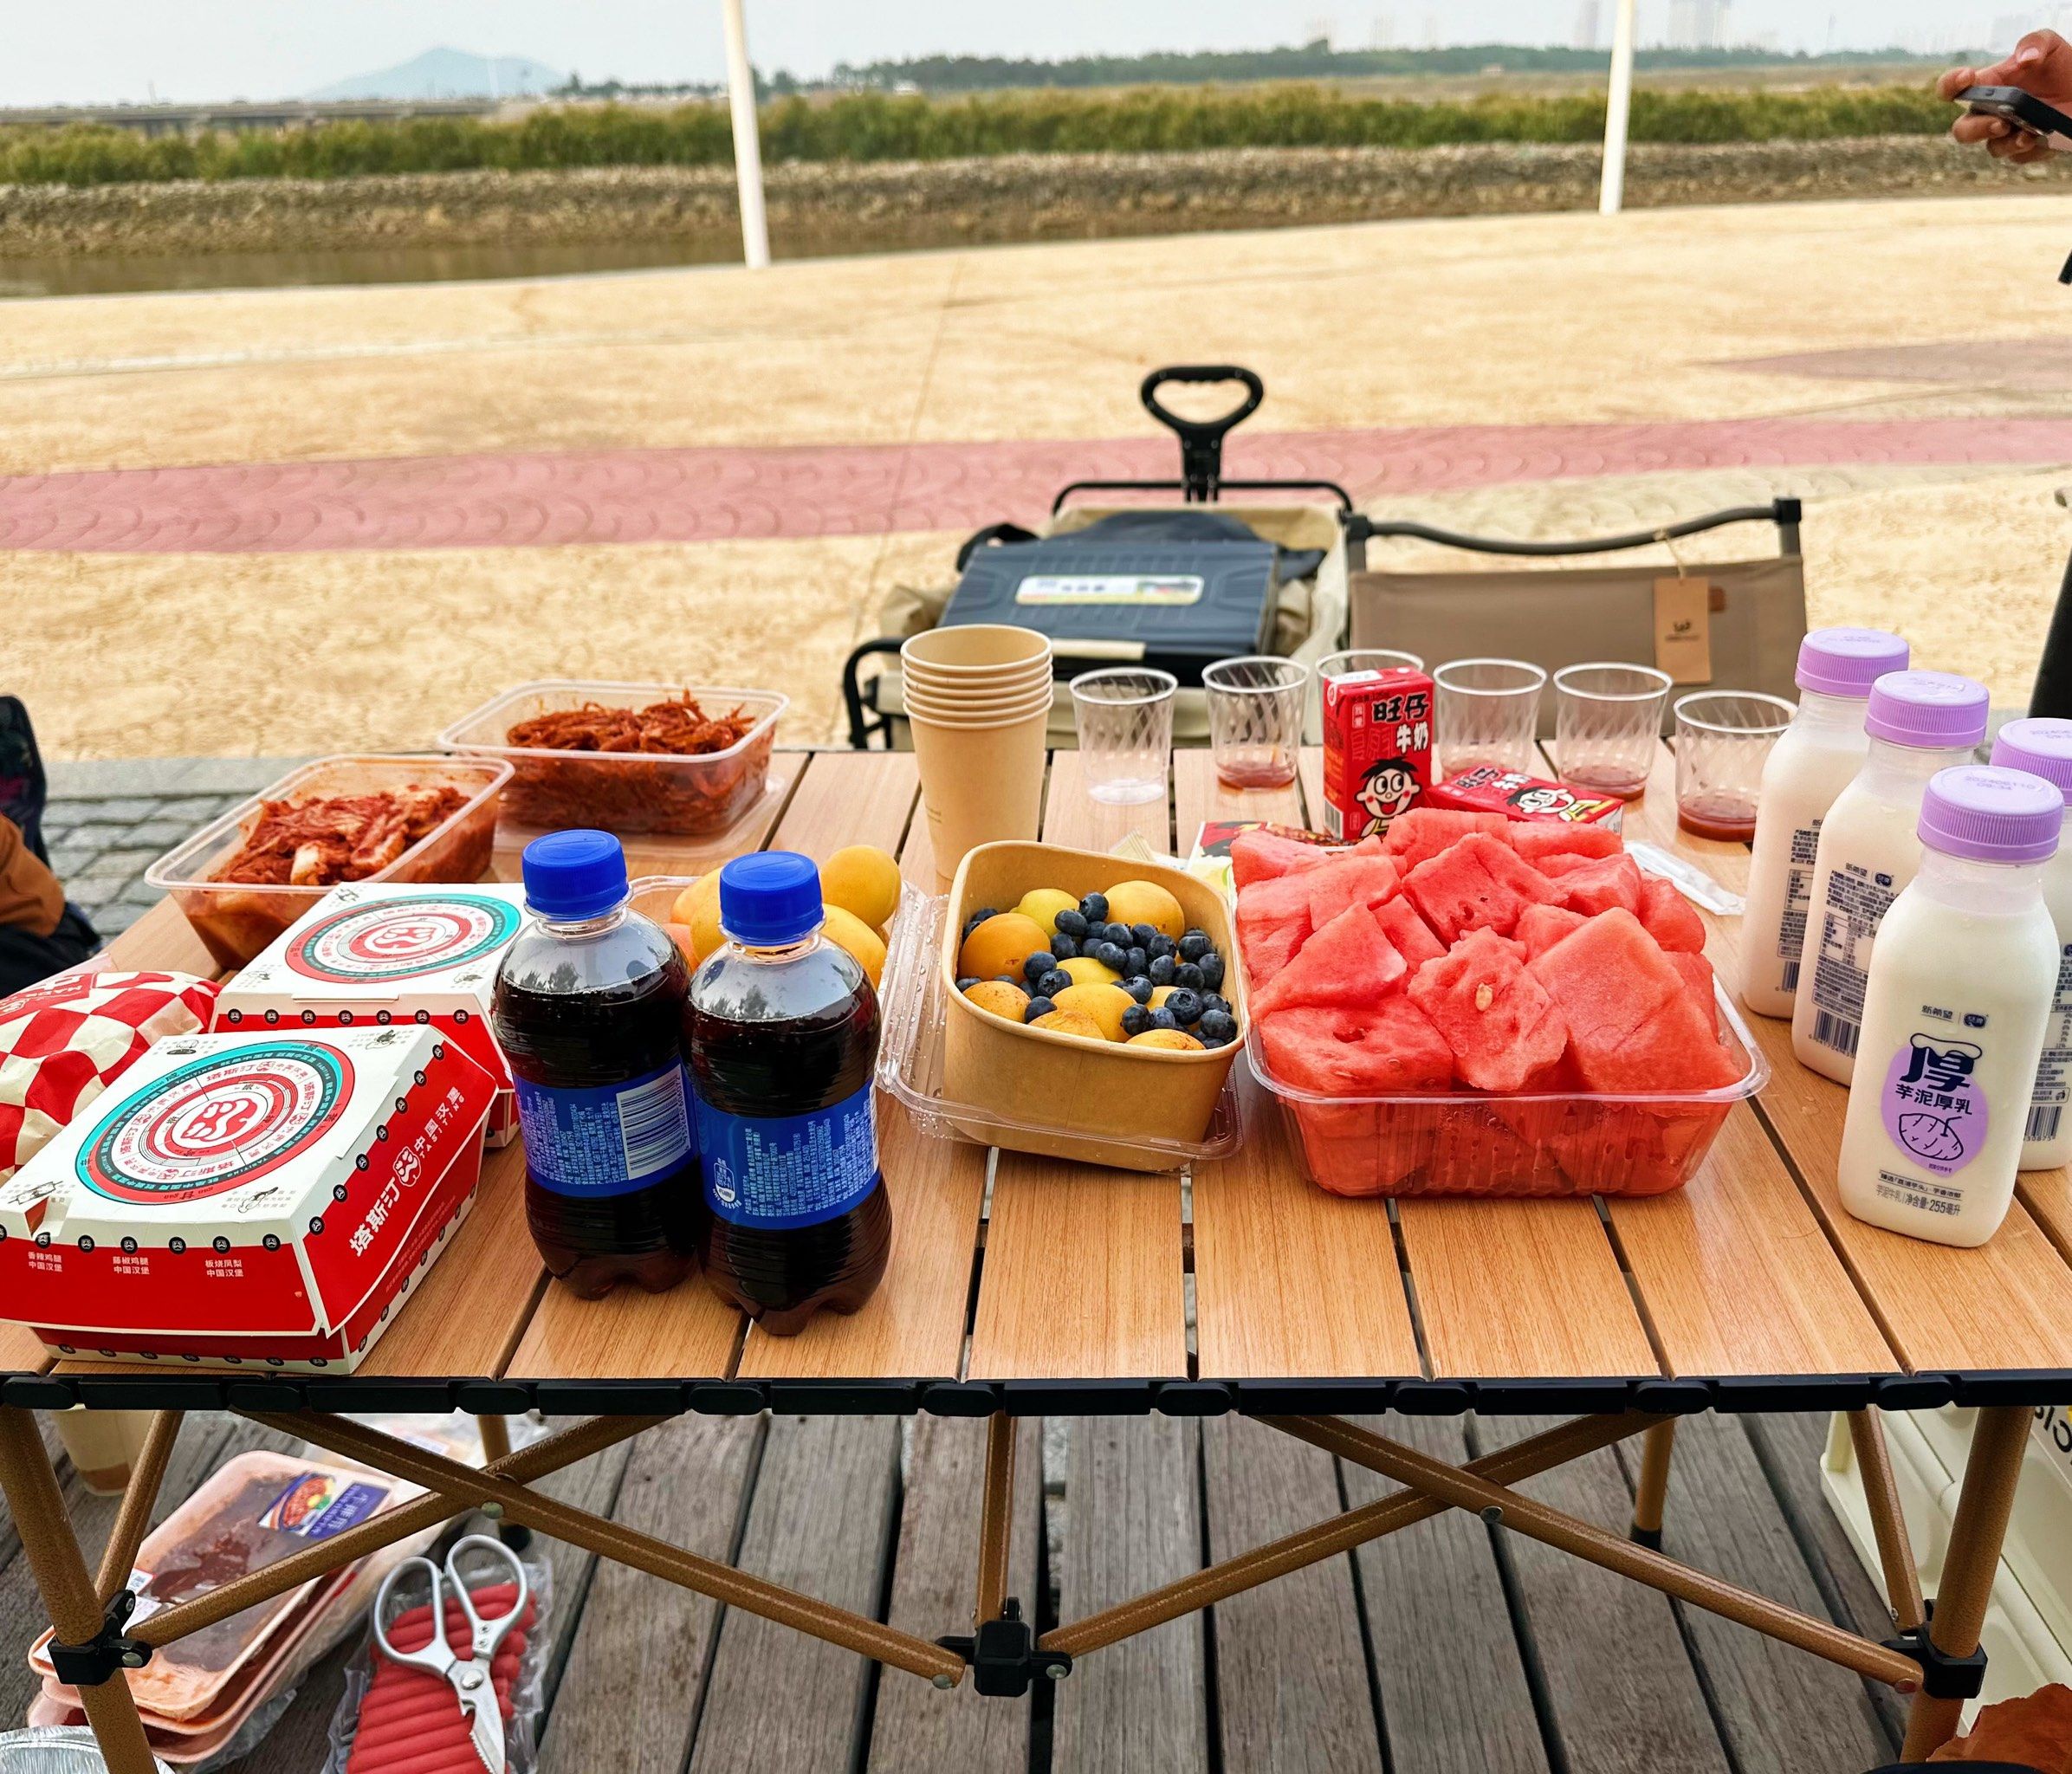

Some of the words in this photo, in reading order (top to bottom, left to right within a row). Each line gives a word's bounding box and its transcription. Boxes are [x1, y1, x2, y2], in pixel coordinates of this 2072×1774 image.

[1372, 692, 1429, 723] 旺仔
[1395, 721, 1428, 754] 牛奶
[1922, 1005, 1953, 1020] 新希望
[1900, 1046, 1974, 1092] 厚
[1895, 1084, 1973, 1115] 芋泥厚乳
[419, 1095, 465, 1159] TASITING
[349, 1176, 401, 1257] 塔斯汀
[413, 1086, 461, 1152] 中国汉堡
[29, 1261, 62, 1272] 中国汉堡
[113, 1266, 150, 1275] 中国汉堡
[204, 1259, 243, 1268] 板烧凤梨
[206, 1268, 243, 1278] 中国汉堡
